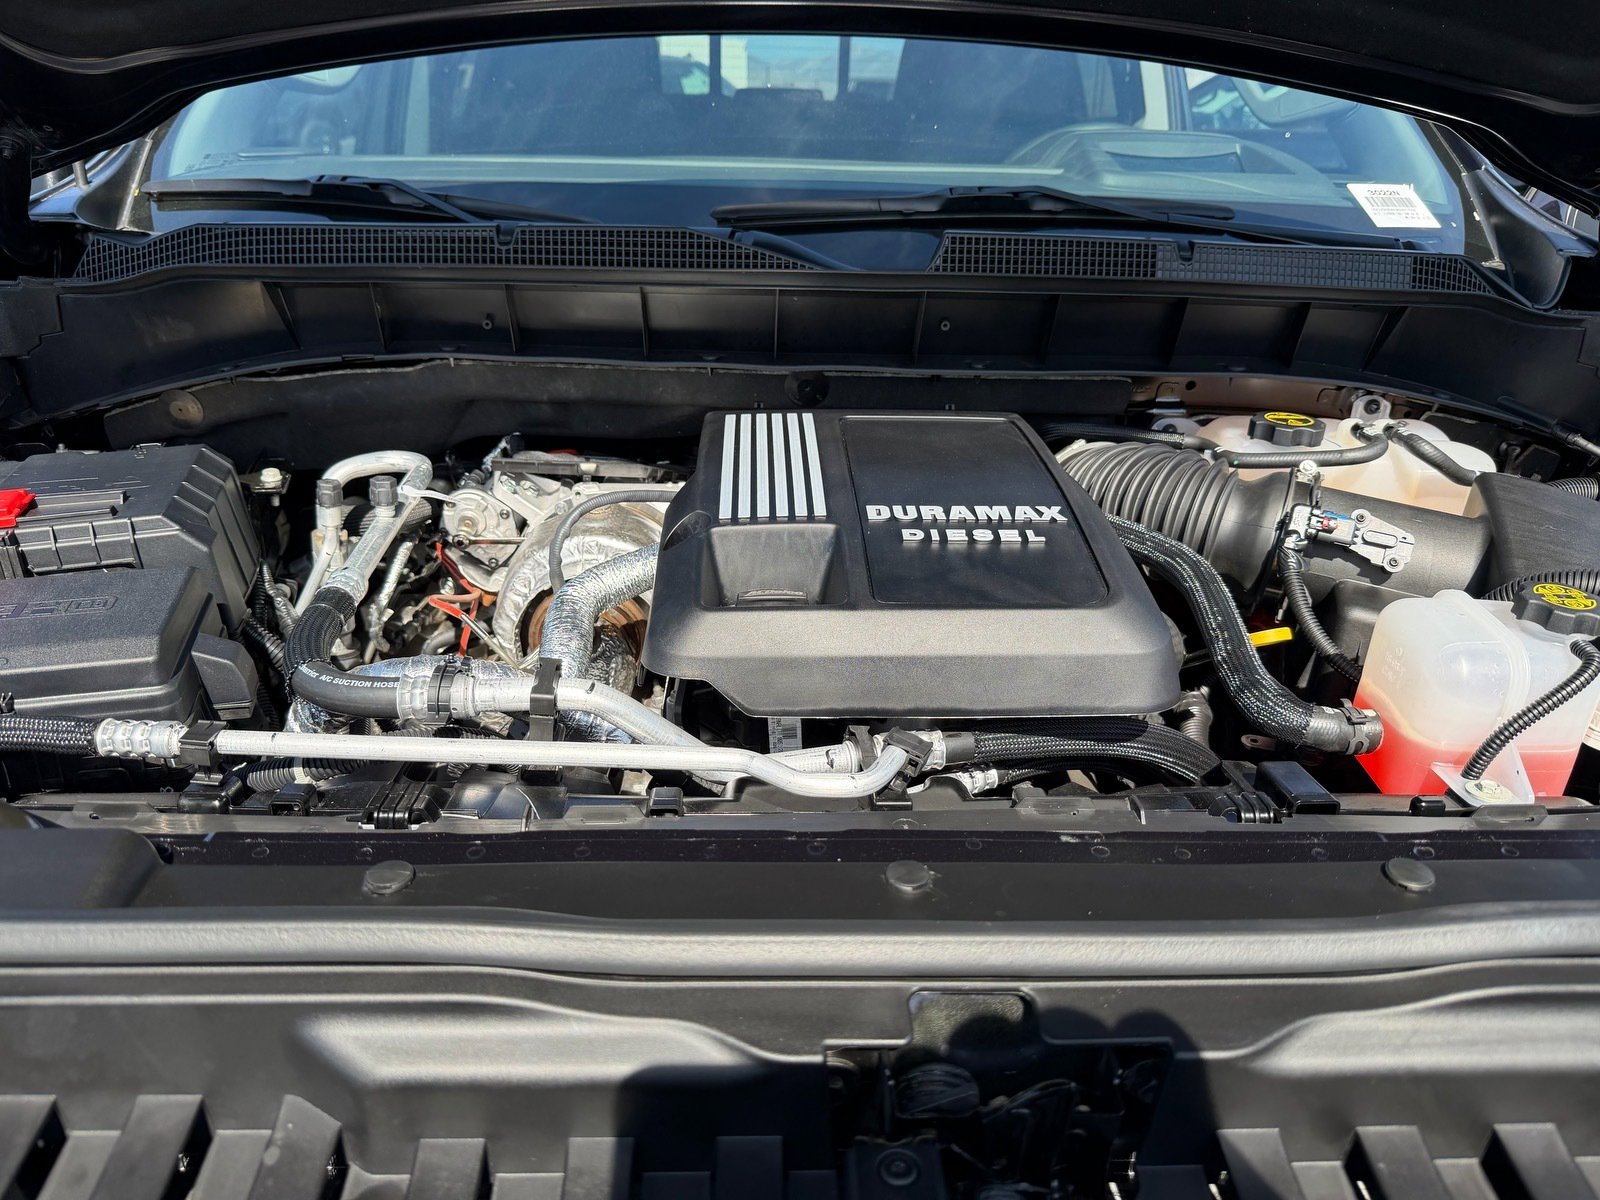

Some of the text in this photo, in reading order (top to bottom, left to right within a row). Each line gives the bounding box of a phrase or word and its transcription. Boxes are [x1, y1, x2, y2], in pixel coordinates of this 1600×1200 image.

[865, 505, 1068, 522] DURAMAX
[901, 529, 1046, 542] DIESEL
[319, 674, 333, 683] A/C
[333, 677, 372, 688] SUCTION
